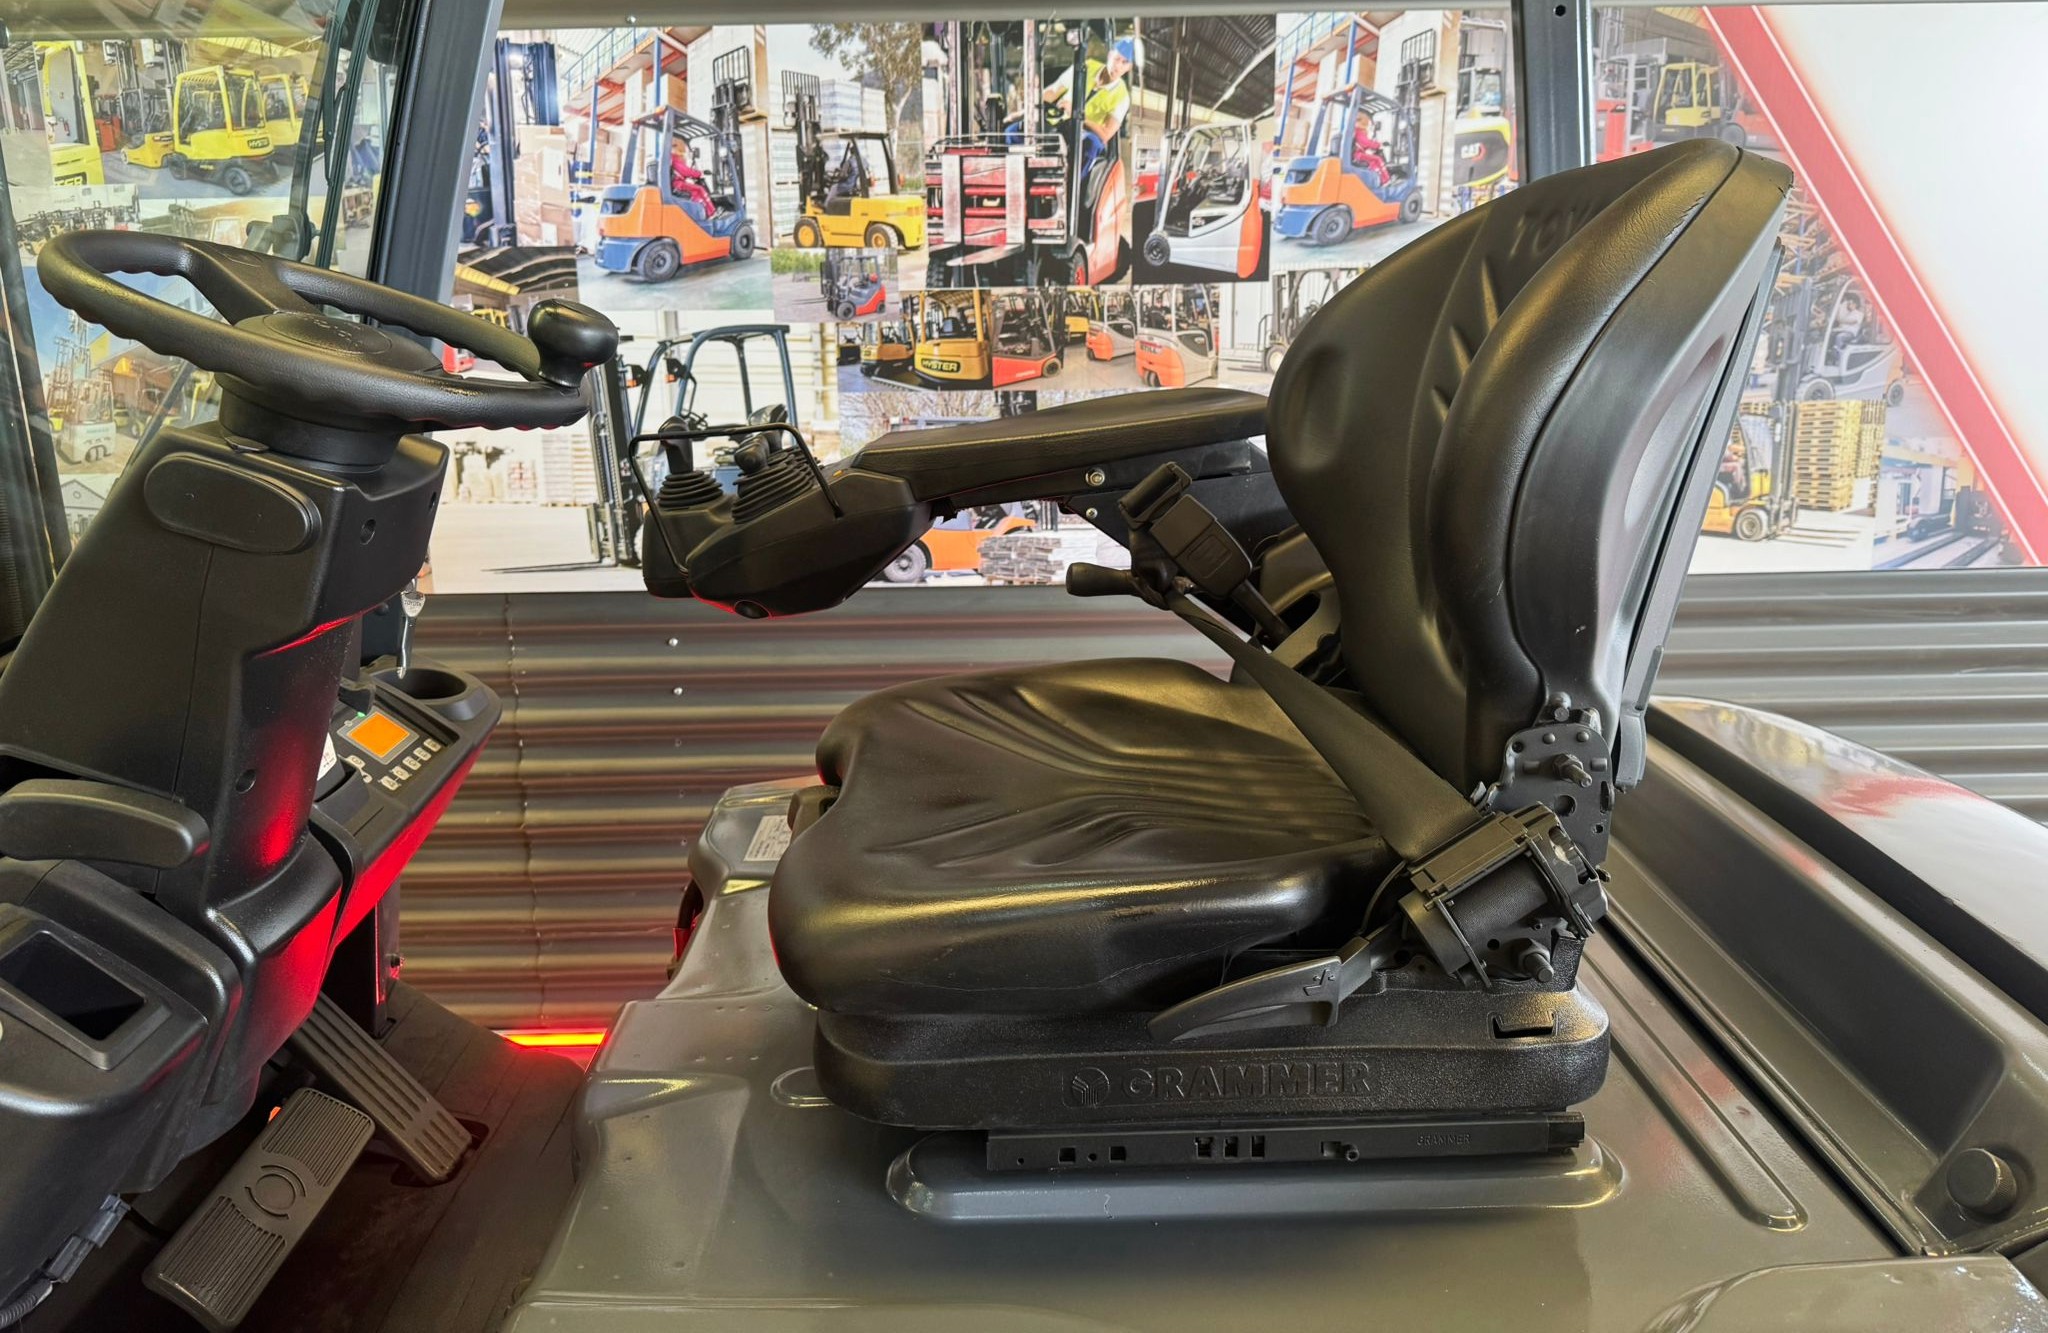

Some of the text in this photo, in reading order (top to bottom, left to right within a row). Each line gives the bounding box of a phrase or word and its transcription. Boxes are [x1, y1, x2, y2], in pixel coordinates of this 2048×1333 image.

[1461, 143, 1480, 158] CAT
[922, 360, 958, 371] HYSTER
[1121, 1060, 1371, 1099] GRAMMER
[1417, 1132, 1471, 1146] GRAMMER
